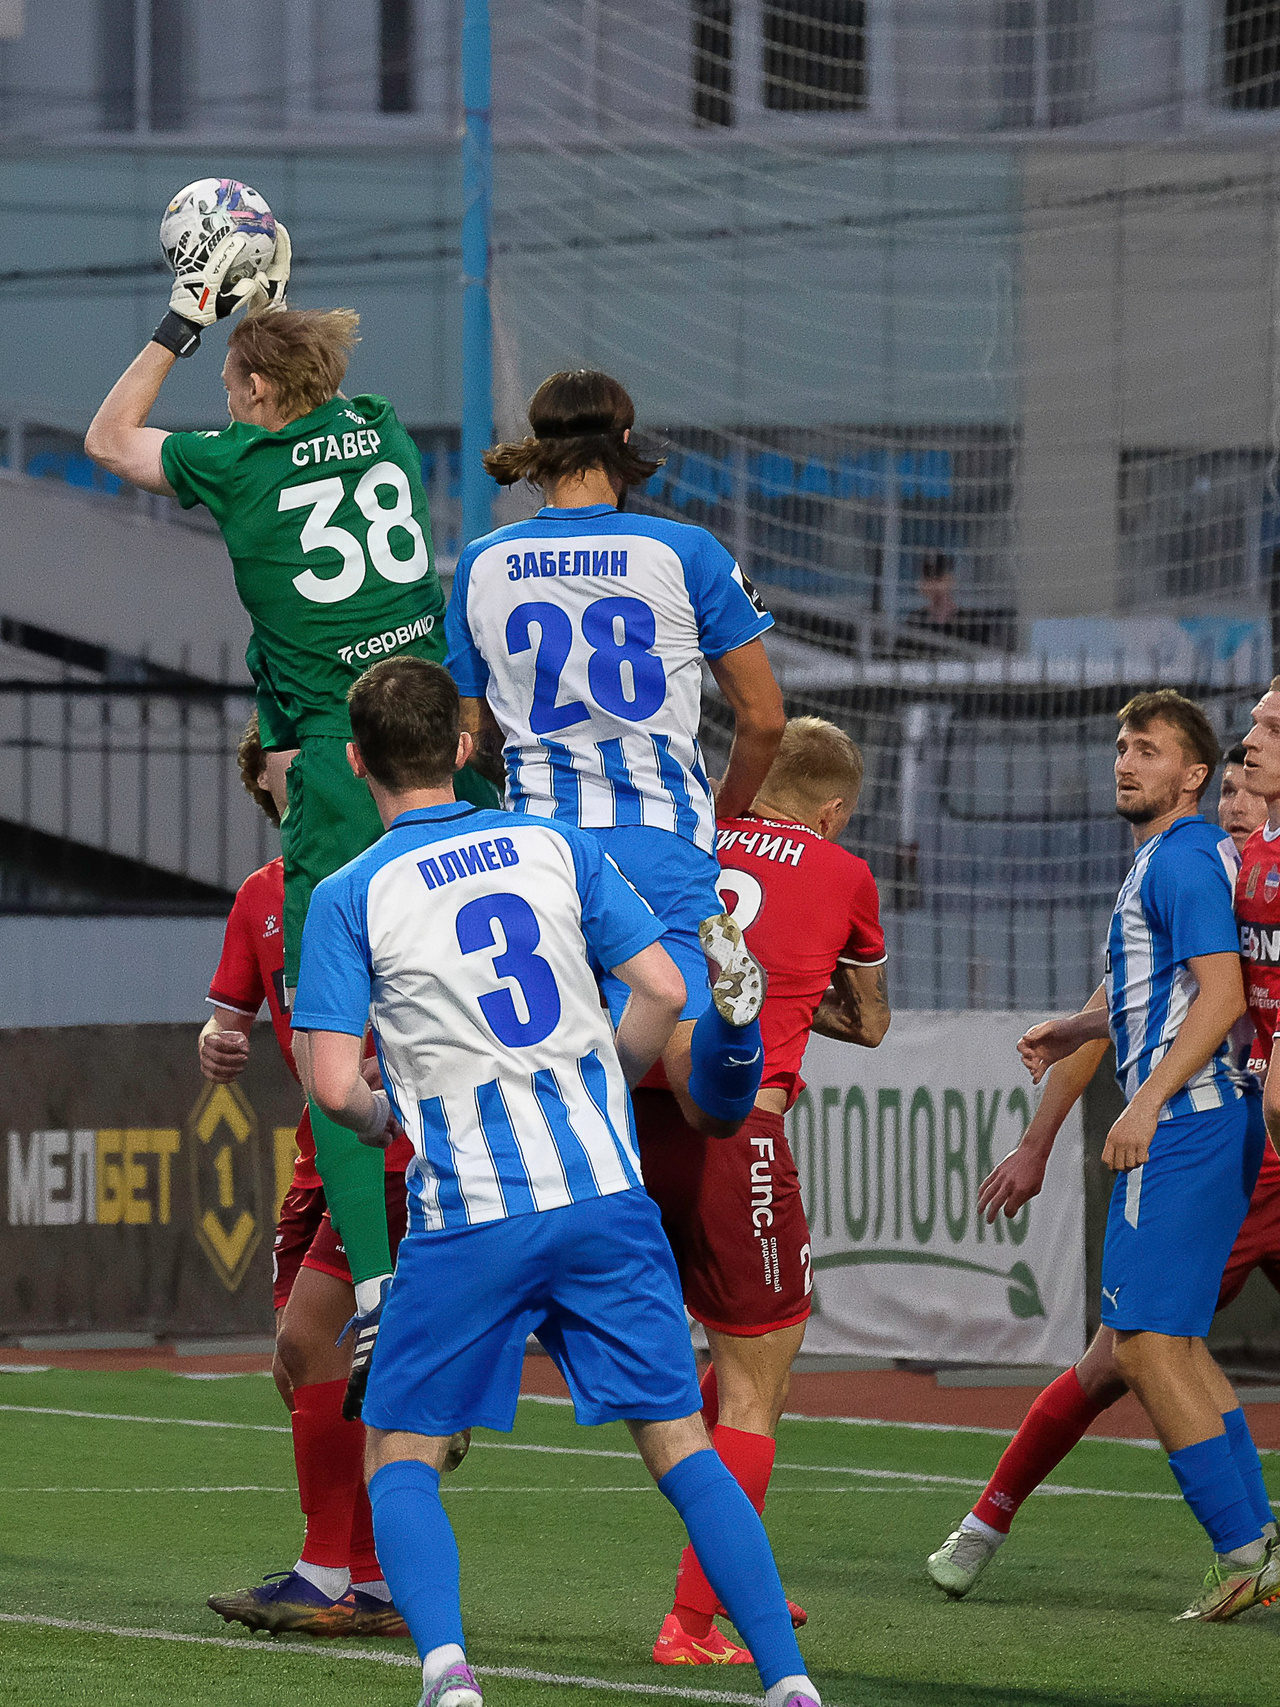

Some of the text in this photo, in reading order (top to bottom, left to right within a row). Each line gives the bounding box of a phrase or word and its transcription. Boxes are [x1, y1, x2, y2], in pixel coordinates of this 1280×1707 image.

[292, 429, 382, 467] СТАВЕР
[278, 461, 429, 604] 38
[506, 550, 628, 581] ЗАБЕЛИН
[505, 596, 666, 735] 28
[416, 837, 520, 890] ПЛИЕВ
[455, 892, 561, 1048] 3
[8, 1128, 181, 1226] МЕЛБЕТ
[750, 1138, 776, 1238] Func.
[760, 1238, 771, 1285] диджитал
[770, 1237, 783, 1293] спортивный
